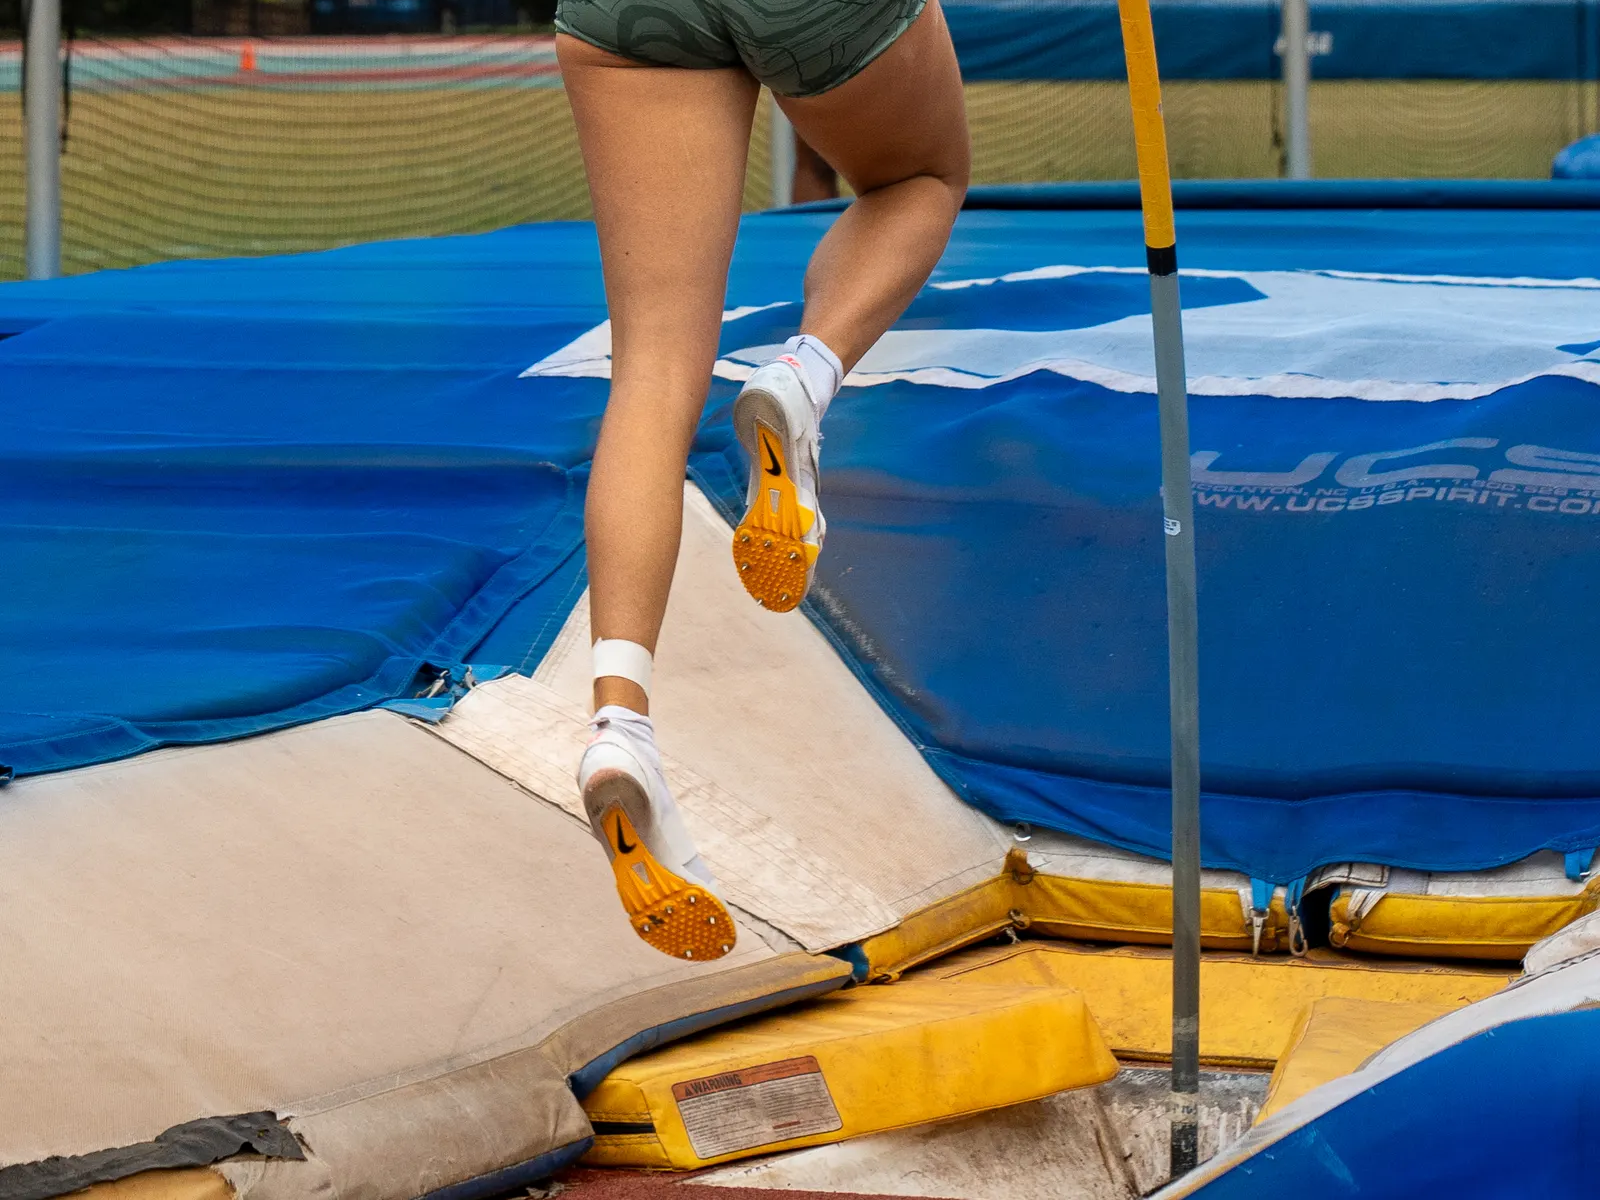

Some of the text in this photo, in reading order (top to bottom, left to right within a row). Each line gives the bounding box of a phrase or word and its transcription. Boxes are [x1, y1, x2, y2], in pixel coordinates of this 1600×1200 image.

[1160, 486, 1600, 515] WW.UCSSPIRIT.CO
[1315, 487, 1348, 497] NC
[690, 1073, 742, 1095] WARNING
